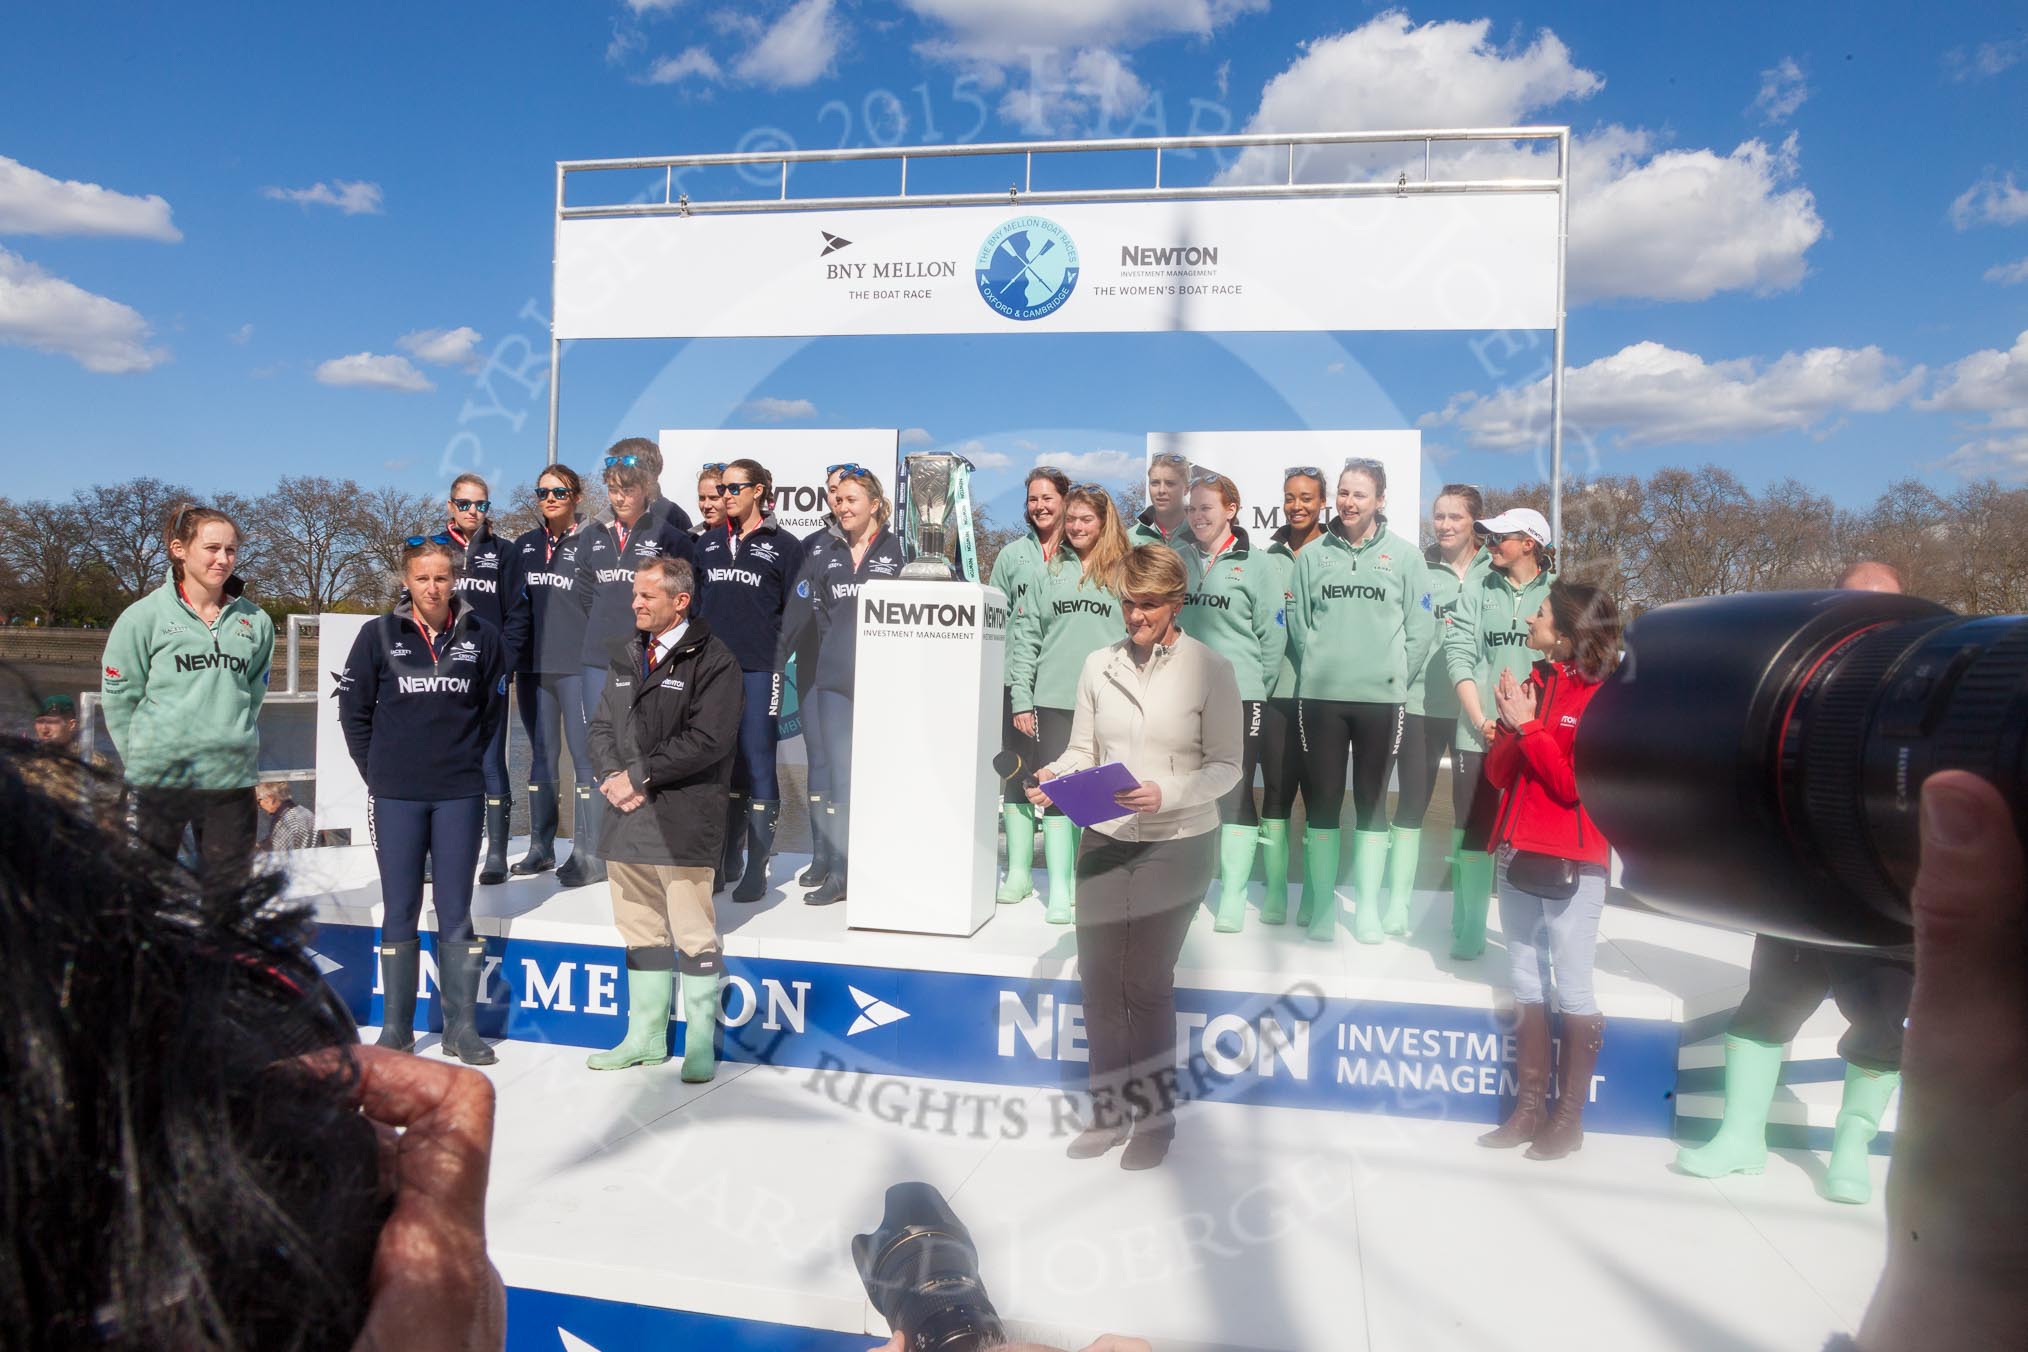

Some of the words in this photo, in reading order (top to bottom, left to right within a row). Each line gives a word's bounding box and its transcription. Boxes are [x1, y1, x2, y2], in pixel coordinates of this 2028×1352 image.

[979, 247, 991, 264] THE
[988, 229, 1004, 247] BNY
[1003, 218, 1039, 233] MELLON
[1041, 220, 1062, 237] BOAT
[1059, 234, 1077, 263] RACES
[1121, 245, 1218, 266] NEWTON
[827, 264, 866, 279] BNY
[873, 261, 956, 278] MELLON
[849, 291, 869, 300] THE
[873, 290, 899, 299] BOAT
[903, 289, 932, 298] RACE
[1093, 286, 1116, 295] THE
[1119, 285, 1175, 295] WOMEN'S
[1179, 285, 1208, 294] BOAT
[1211, 285, 1243, 294] RACE
[983, 287, 1013, 315] OXFORD
[1014, 309, 1021, 318] &
[1022, 287, 1070, 318] CAMBRIDGE
[451, 577, 497, 594] EWTON
[708, 568, 762, 587] NEWTON
[1321, 584, 1386, 602] NEWTON
[864, 599, 976, 627] NEWTON
[1053, 600, 1112, 618] NEWTON
[863, 630, 913, 638] INVESTMENT
[916, 631, 975, 640] MANAGEMENT
[175, 653, 250, 675] NEWTON
[398, 676, 471, 694] NEWTON
[768, 673, 780, 716] NEWTO
[520, 958, 812, 1034] MEON
[998, 990, 1310, 1081] NETON
